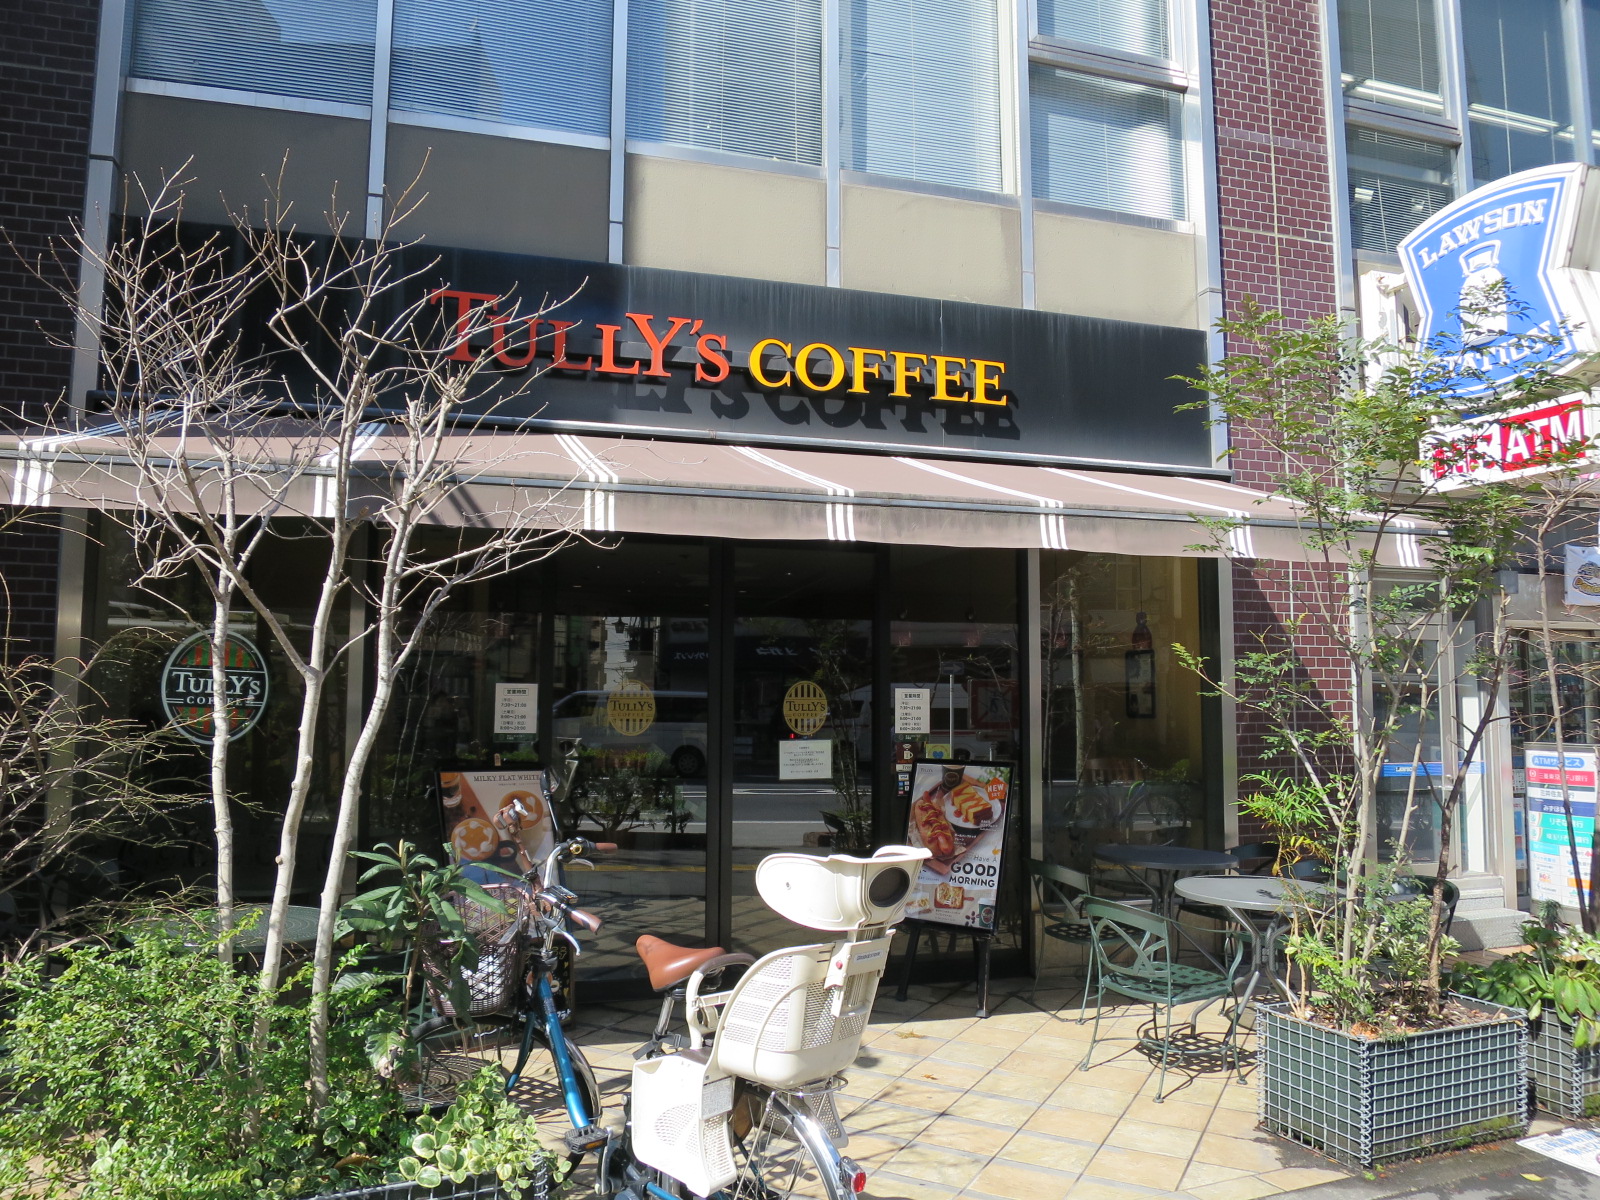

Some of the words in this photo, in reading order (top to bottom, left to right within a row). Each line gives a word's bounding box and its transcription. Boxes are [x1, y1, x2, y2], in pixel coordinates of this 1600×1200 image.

[1418, 199, 1548, 270] LAWSON
[431, 288, 731, 384] TULLY'S
[749, 338, 1008, 407] COFFEE
[1429, 320, 1551, 376] TATION
[1505, 407, 1581, 464] ATM
[172, 671, 261, 696] TULY'S
[186, 695, 243, 707] COFEE
[610, 699, 653, 712] TULLY'S
[785, 700, 826, 712] TULLY'S
[1533, 756, 1582, 767] ATMサビス
[987, 784, 1004, 793] NEW
[950, 862, 997, 877] GOOD
[949, 875, 996, 888] MORNING
